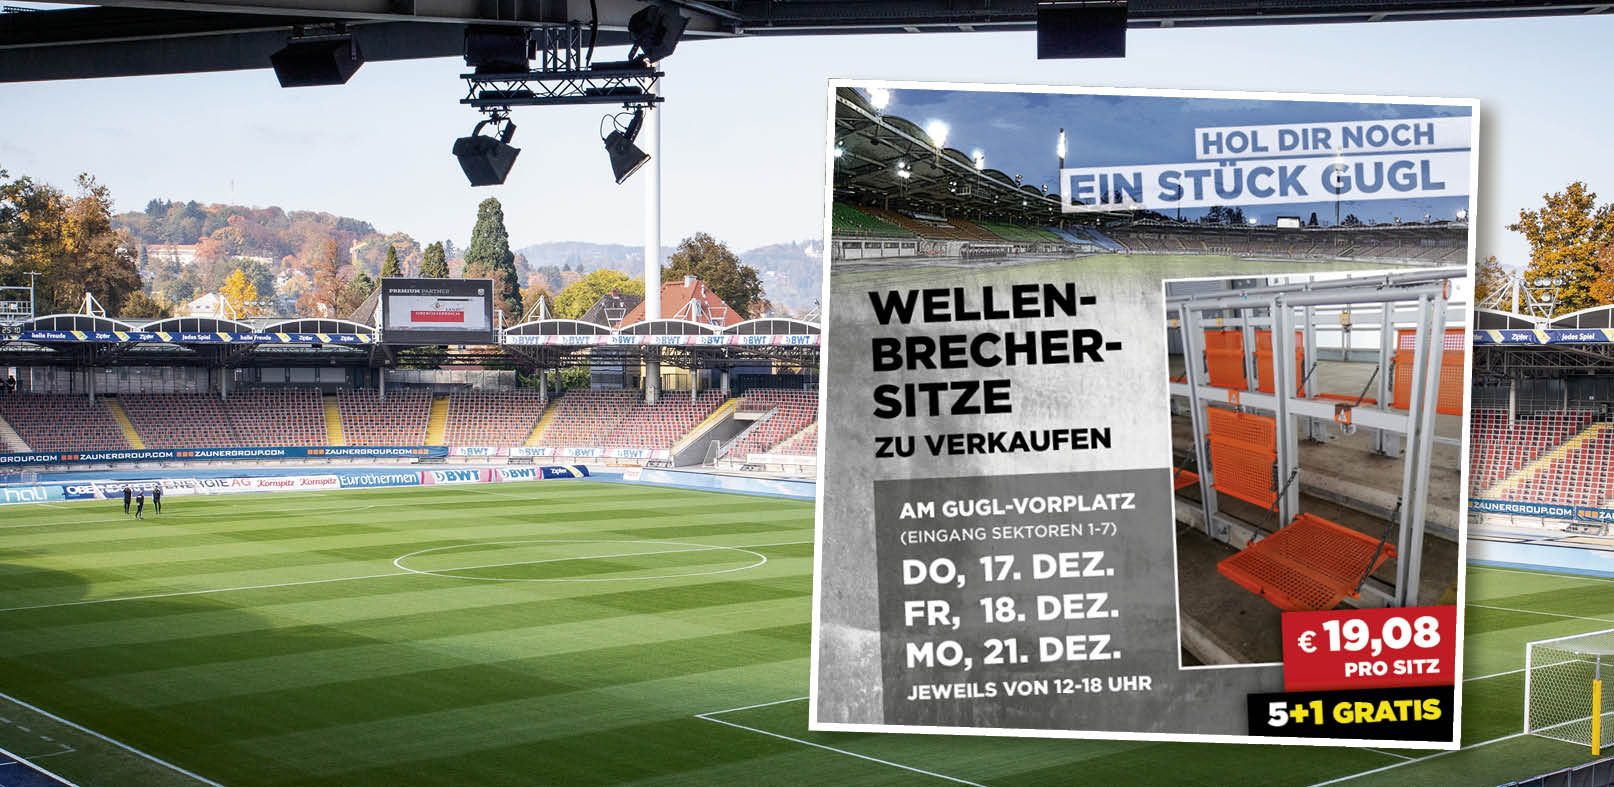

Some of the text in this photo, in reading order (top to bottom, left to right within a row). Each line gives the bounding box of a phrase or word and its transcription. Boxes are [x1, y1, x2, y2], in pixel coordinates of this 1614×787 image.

[80, 452, 173, 461] ZAUNERGROUP.COM
[194, 449, 285, 457] ZAUNERGROUP.COM
[445, 470, 480, 482] BWT
[511, 468, 537, 478] BWT
[300, 478, 337, 486] Kornspitz
[340, 472, 416, 486] Eurothermen
[257, 480, 295, 488] Kornspitz
[1474, 502, 1572, 516] ZAUNERGROUP.COM
